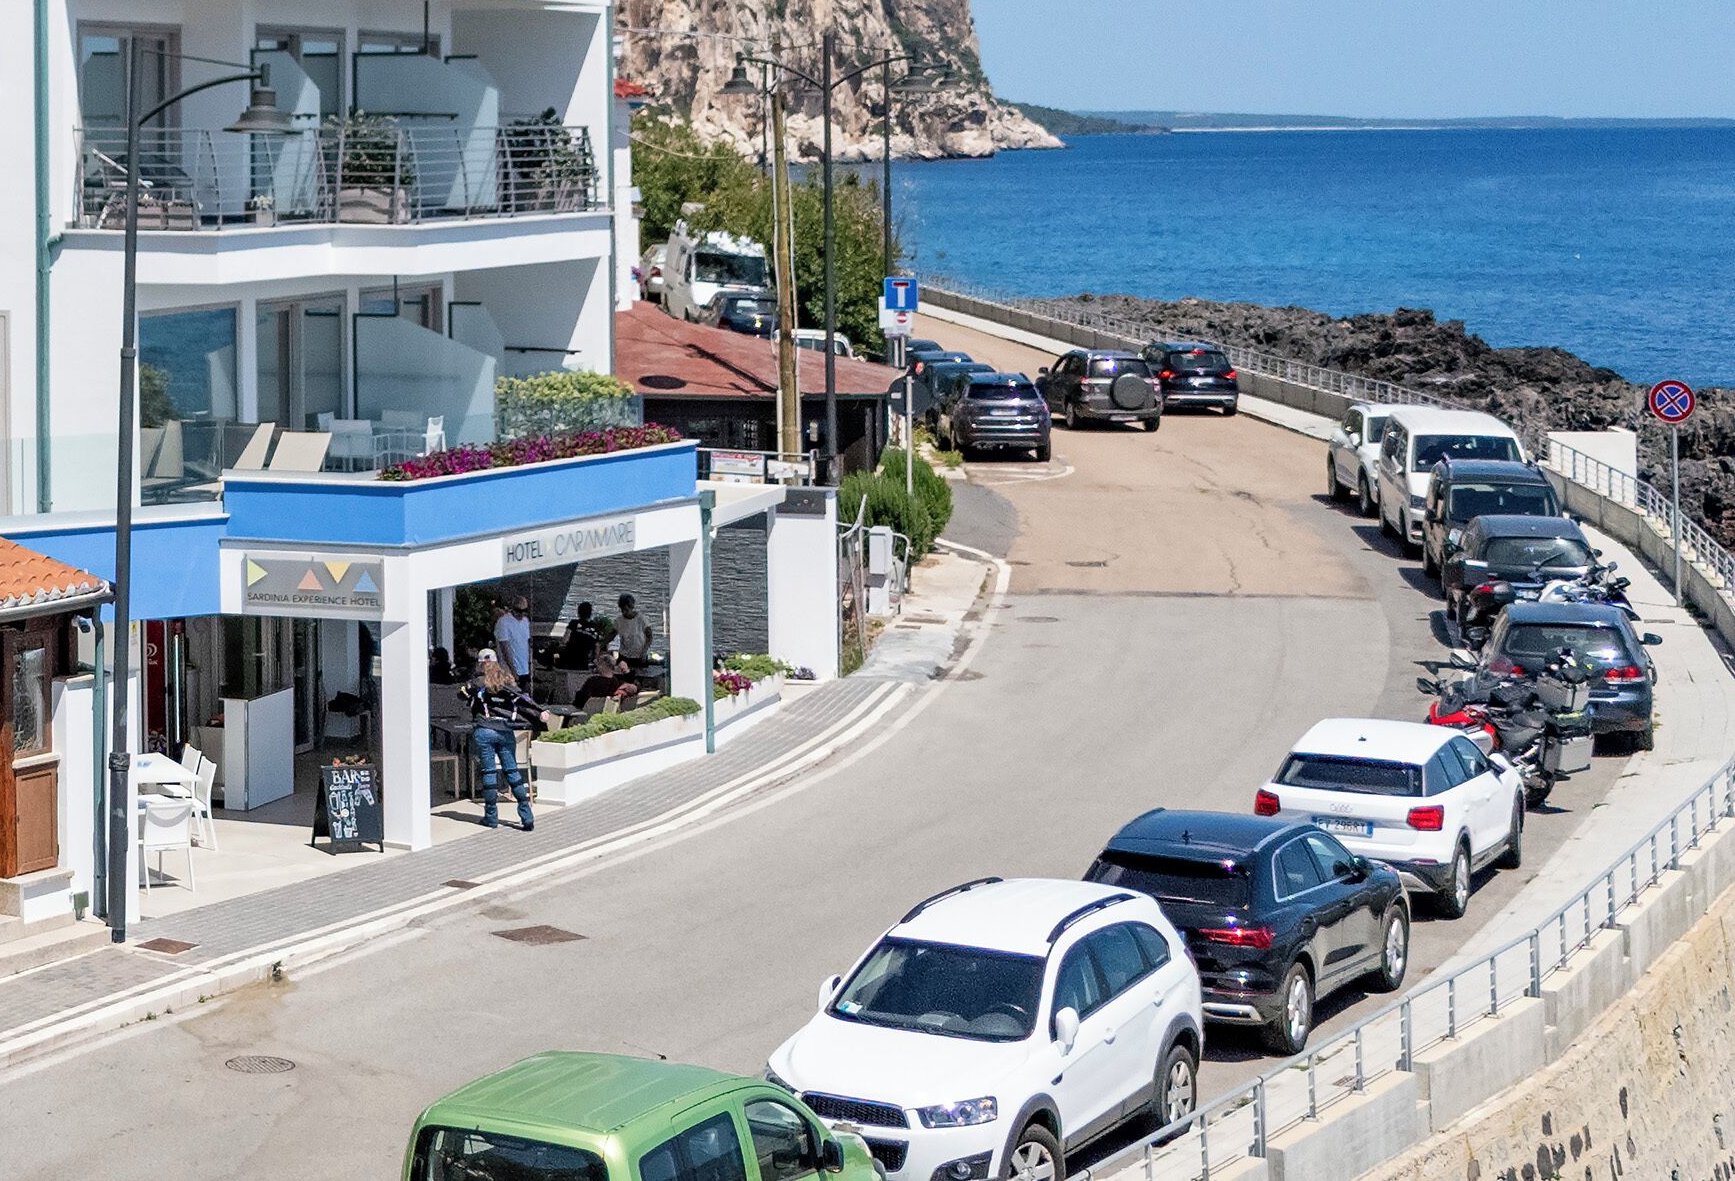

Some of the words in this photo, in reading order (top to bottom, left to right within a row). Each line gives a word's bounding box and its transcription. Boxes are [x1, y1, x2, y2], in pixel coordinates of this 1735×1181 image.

[506, 540, 543, 563] HOTEL
[554, 521, 634, 556] CARAMARE
[247, 593, 289, 602] SARDINIA
[292, 594, 347, 605] EXPERIENCE
[350, 597, 381, 607] HOTEL
